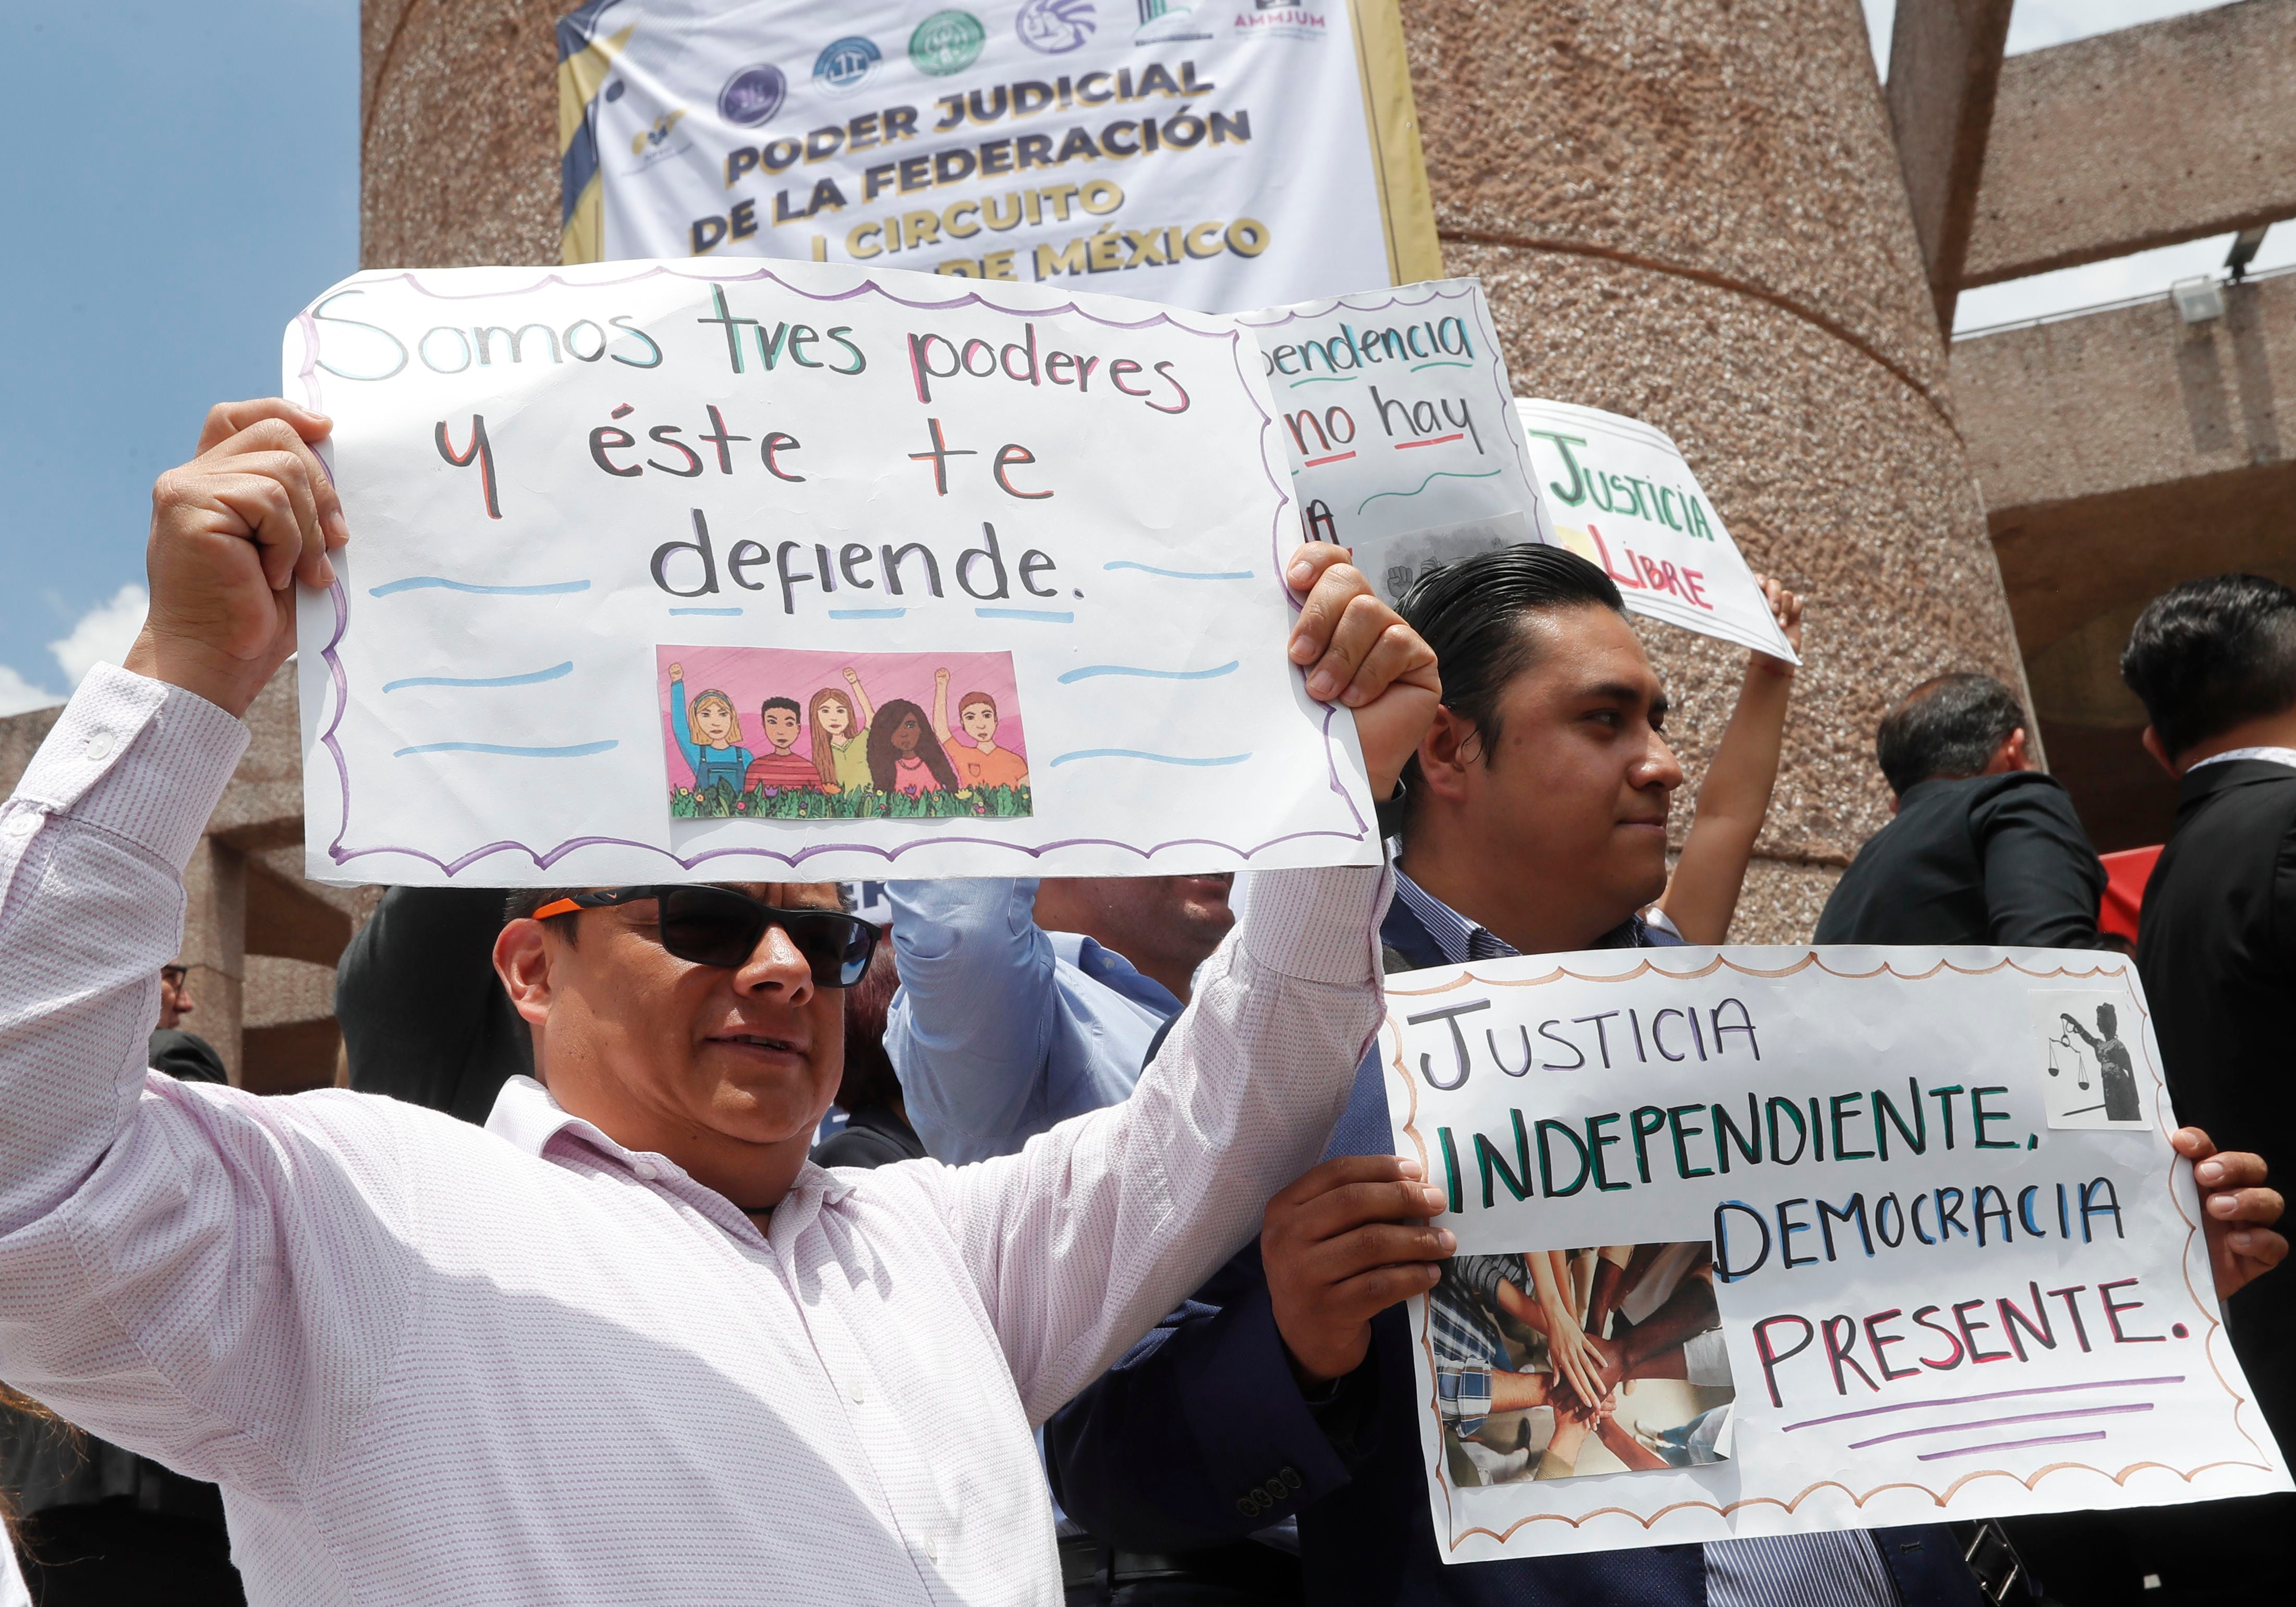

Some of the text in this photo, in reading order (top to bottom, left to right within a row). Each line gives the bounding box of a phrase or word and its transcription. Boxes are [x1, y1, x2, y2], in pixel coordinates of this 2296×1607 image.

[1234, 10, 1326, 28] AMMJUM
[725, 60, 1214, 189] PODER JUDICIAL
[689, 106, 1252, 256] DE LA FEDERACIÓN
[845, 179, 1125, 259] CIRCUITO
[1033, 217, 1271, 282] MÉXICO
[311, 288, 663, 382] Somos
[907, 322, 1190, 415] poderes
[588, 402, 807, 483] éste
[908, 418, 1055, 499] te
[1283, 385, 1485, 455] no hay
[649, 506, 1085, 615] defiende.
[1587, 524, 1714, 611] LIBRE
[1406, 997, 1760, 1091] JUSTICIA
[1711, 1177, 2124, 1283] DEMOCRACIA
[1752, 1277, 2190, 1408] PRESENTE.
